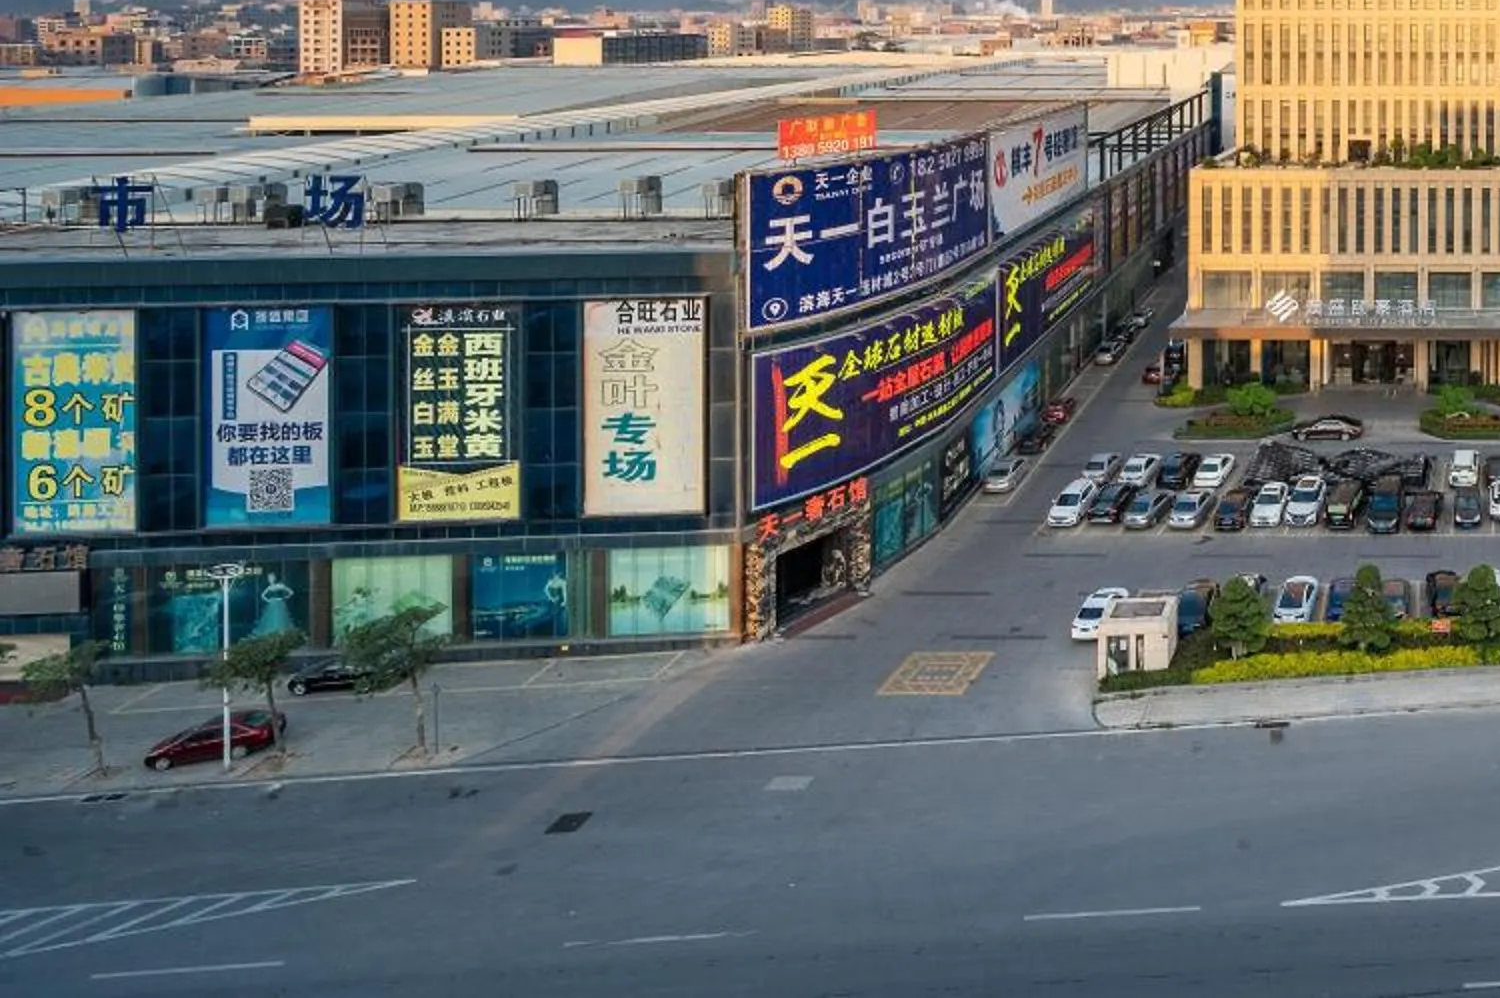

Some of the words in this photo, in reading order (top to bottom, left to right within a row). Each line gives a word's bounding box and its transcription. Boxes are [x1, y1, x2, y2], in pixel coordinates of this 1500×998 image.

[763, 169, 985, 272] 天一白玉兰广场
[615, 300, 701, 324] 合旺石业
[216, 421, 323, 443] 你要找的板
[413, 332, 435, 459] 金丝白玉
[437, 332, 459, 459] 金玉满堂
[463, 332, 504, 459] 西班牙米黄
[227, 445, 312, 466] 都在这里
